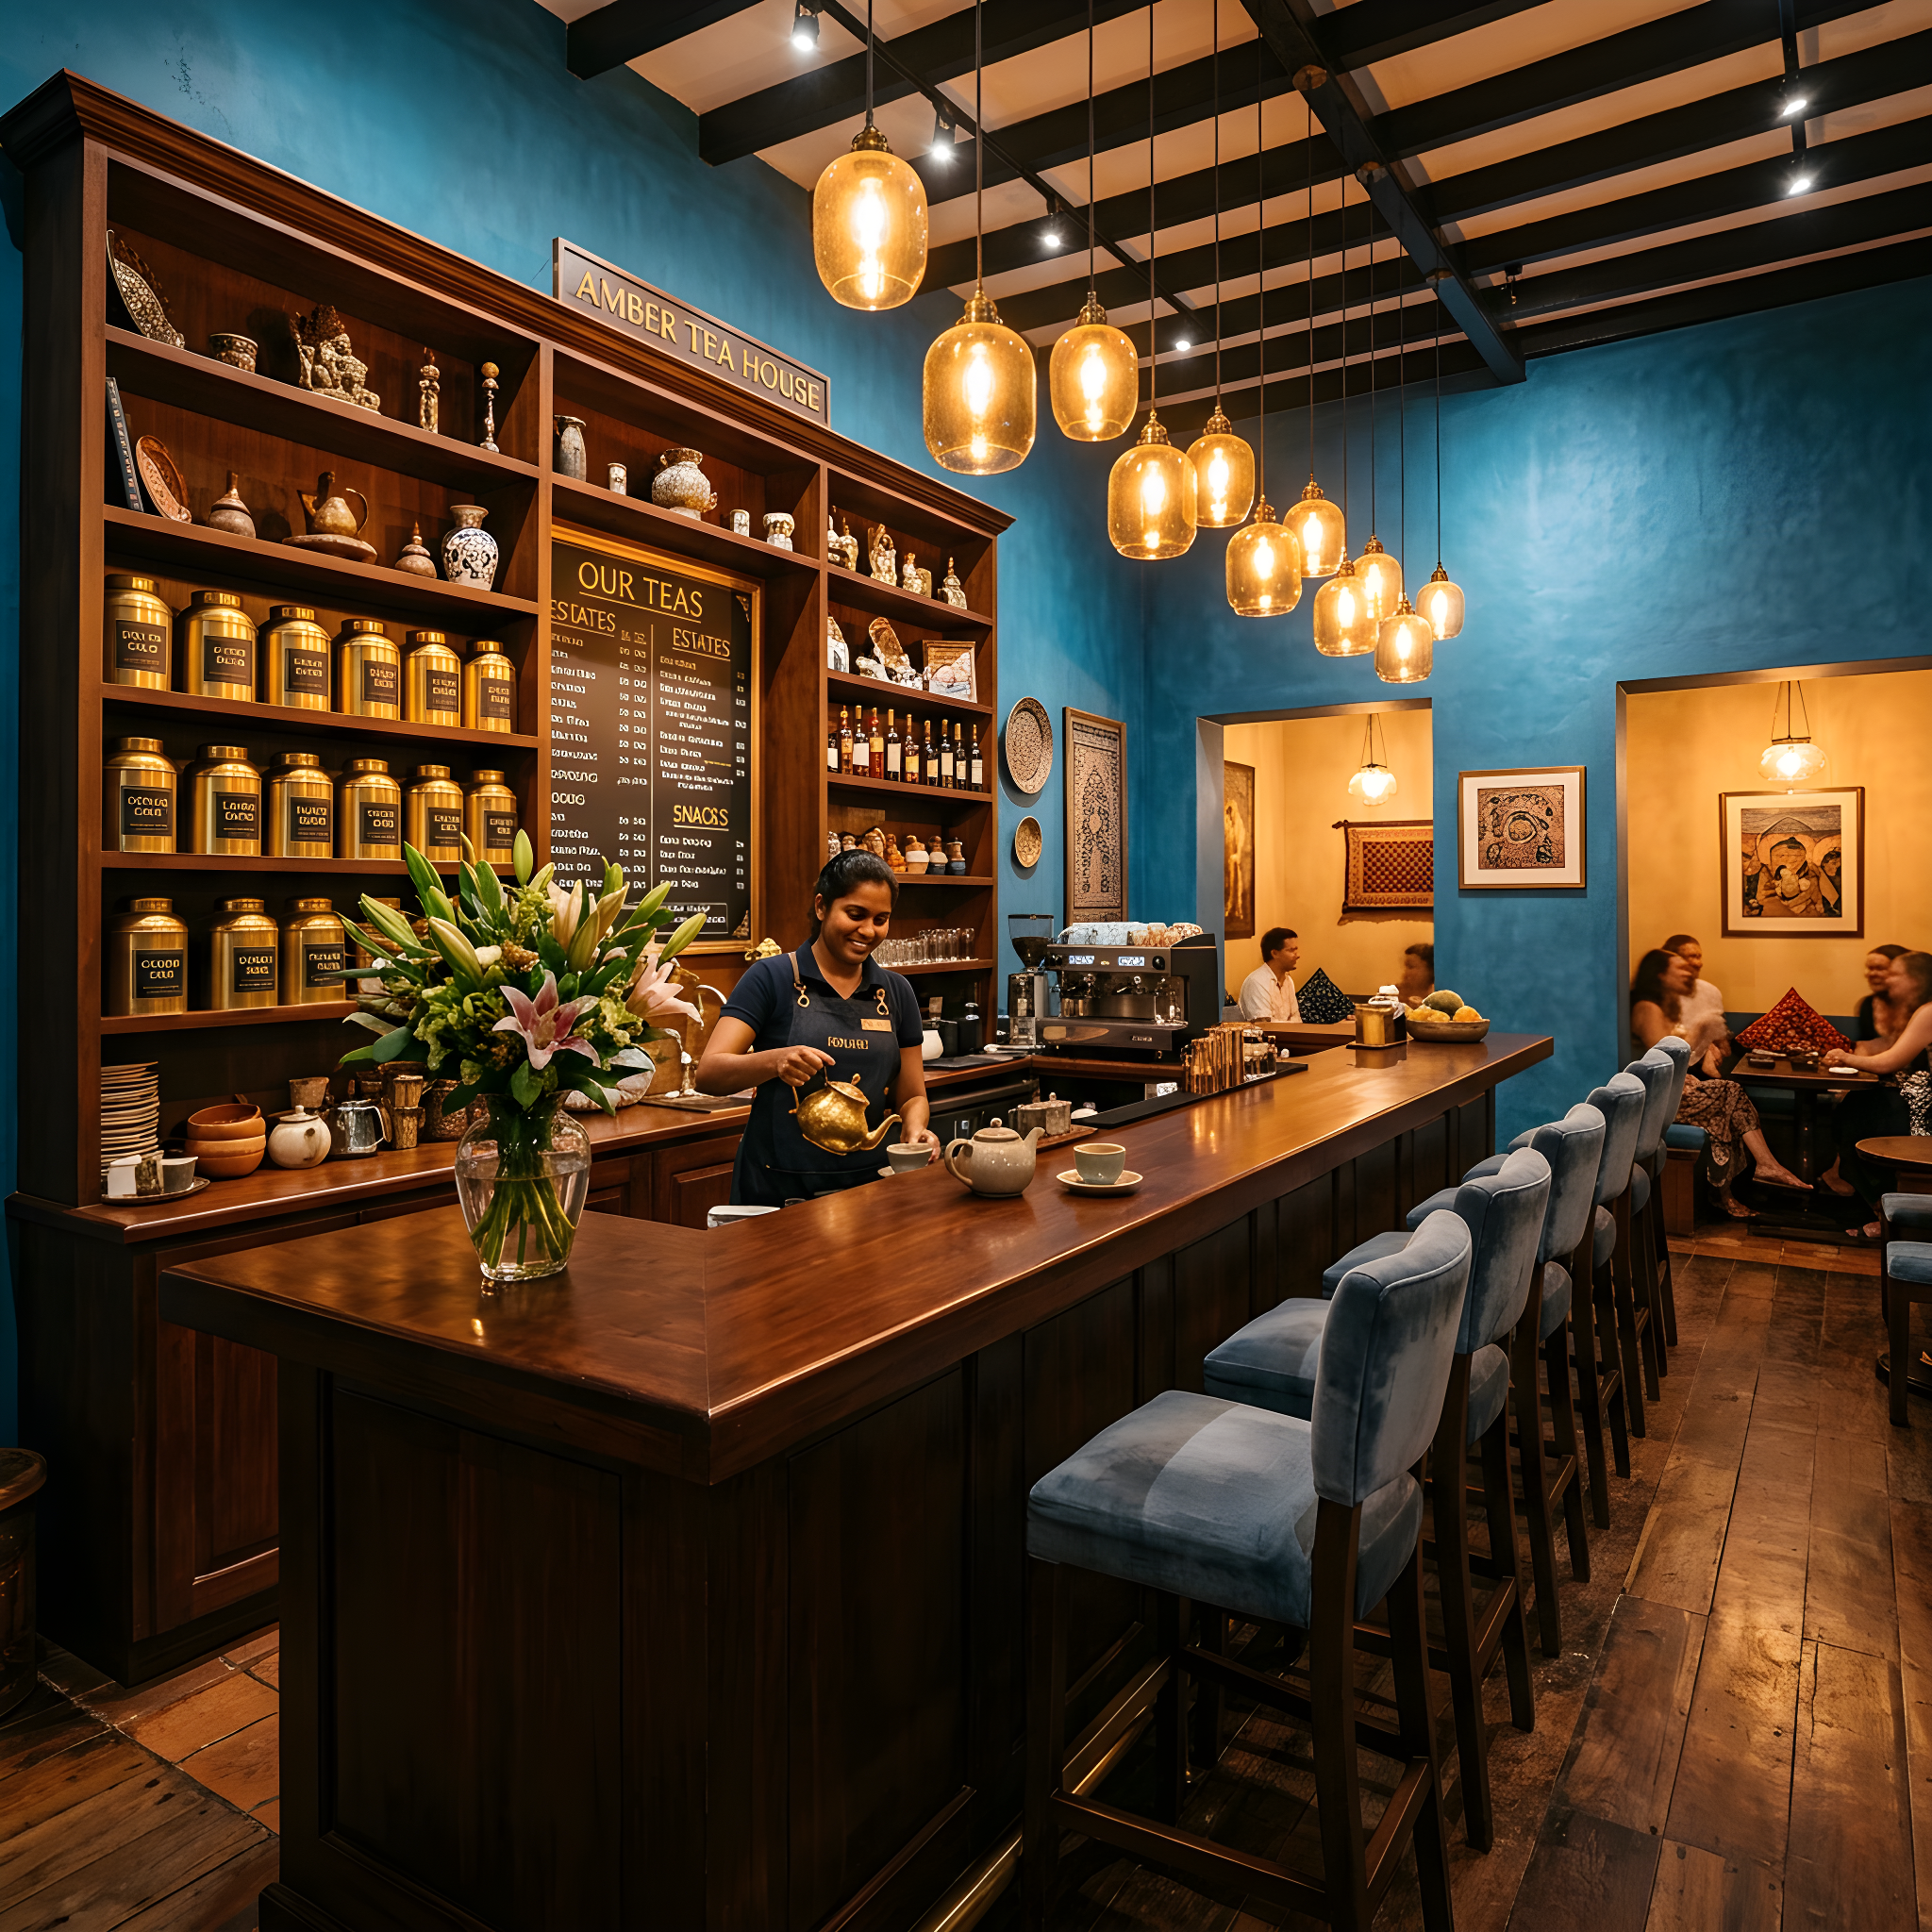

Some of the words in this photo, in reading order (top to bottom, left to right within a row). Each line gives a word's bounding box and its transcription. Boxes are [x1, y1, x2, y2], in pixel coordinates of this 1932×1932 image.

[575, 271, 677, 344] AMBER
[684, 319, 735, 372] TEA
[741, 349, 821, 412] HOUSE
[578, 561, 635, 601] OUR
[642, 576, 703, 618] TEAS
[673, 626, 731, 658] ESTATES
